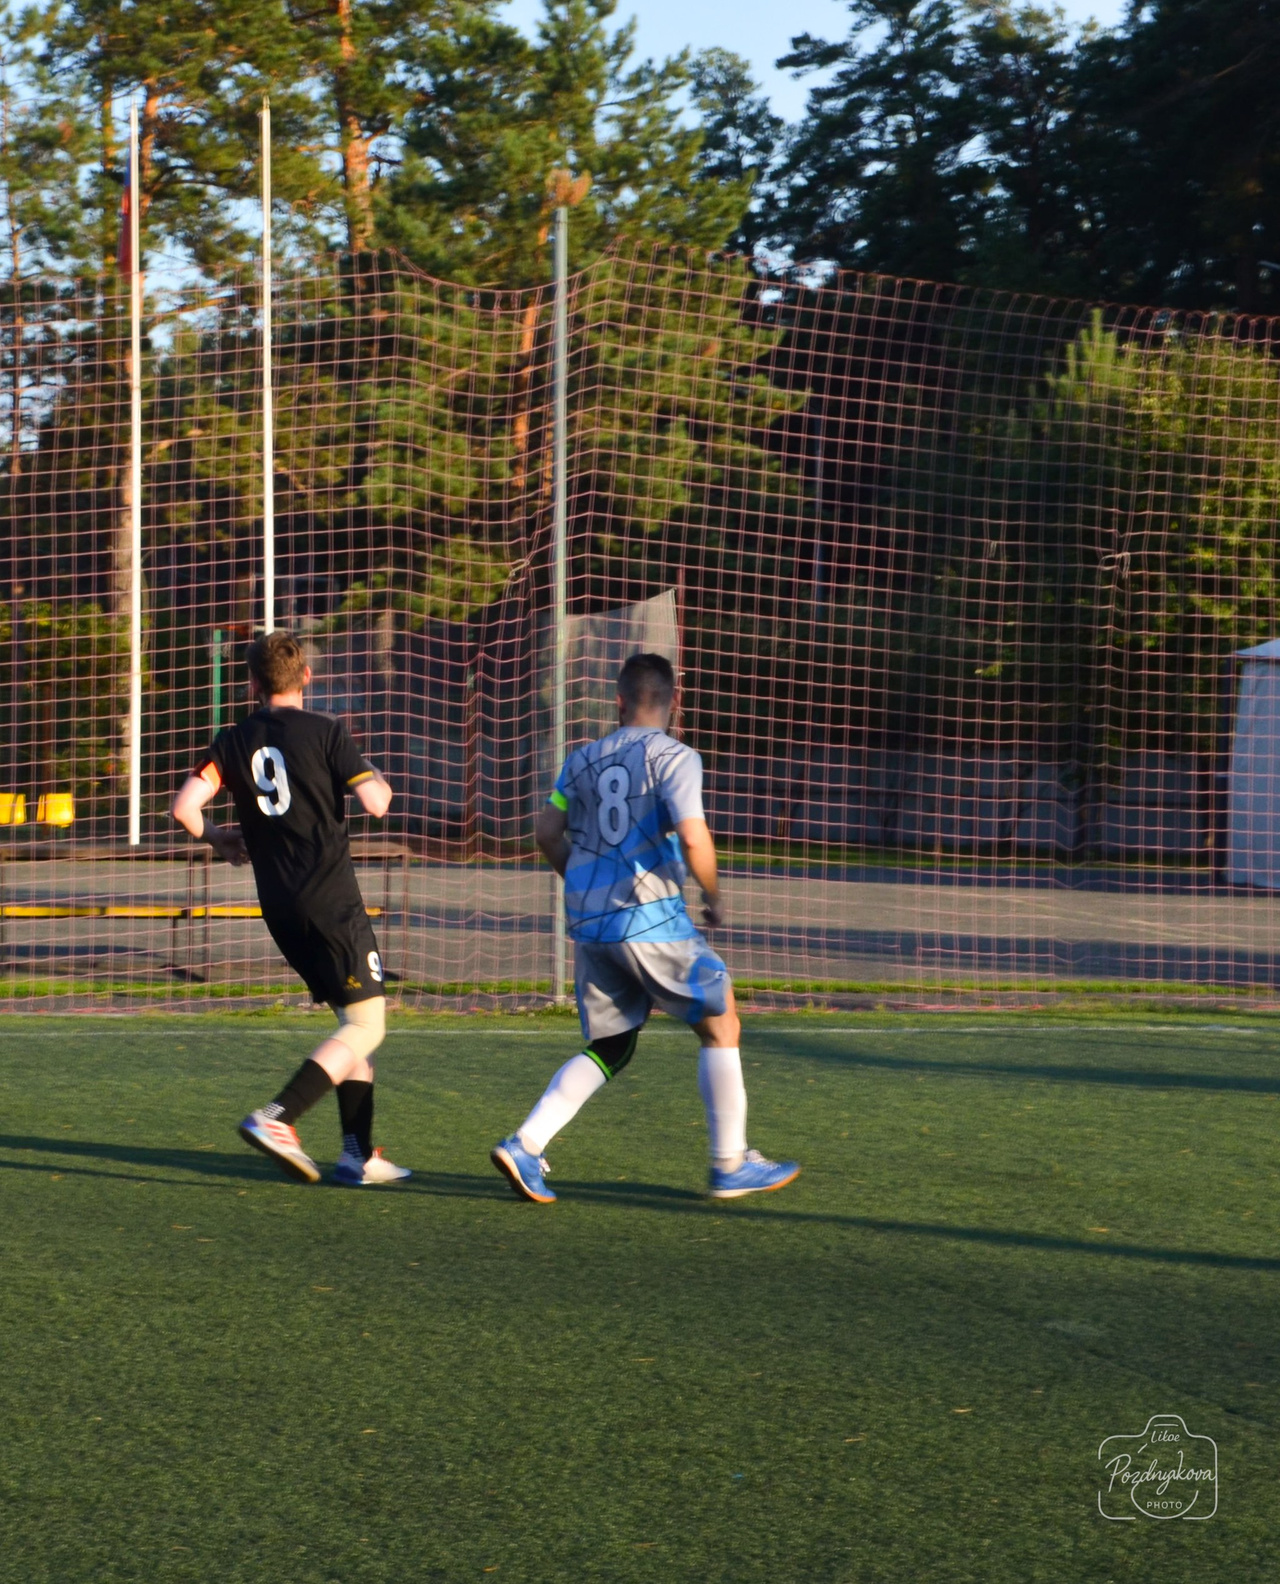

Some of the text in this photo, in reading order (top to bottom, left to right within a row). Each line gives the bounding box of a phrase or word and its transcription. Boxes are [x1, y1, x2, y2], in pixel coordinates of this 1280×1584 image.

[251, 746, 291, 816] 9
[598, 763, 631, 847] 8
[368, 951, 382, 982] 9
